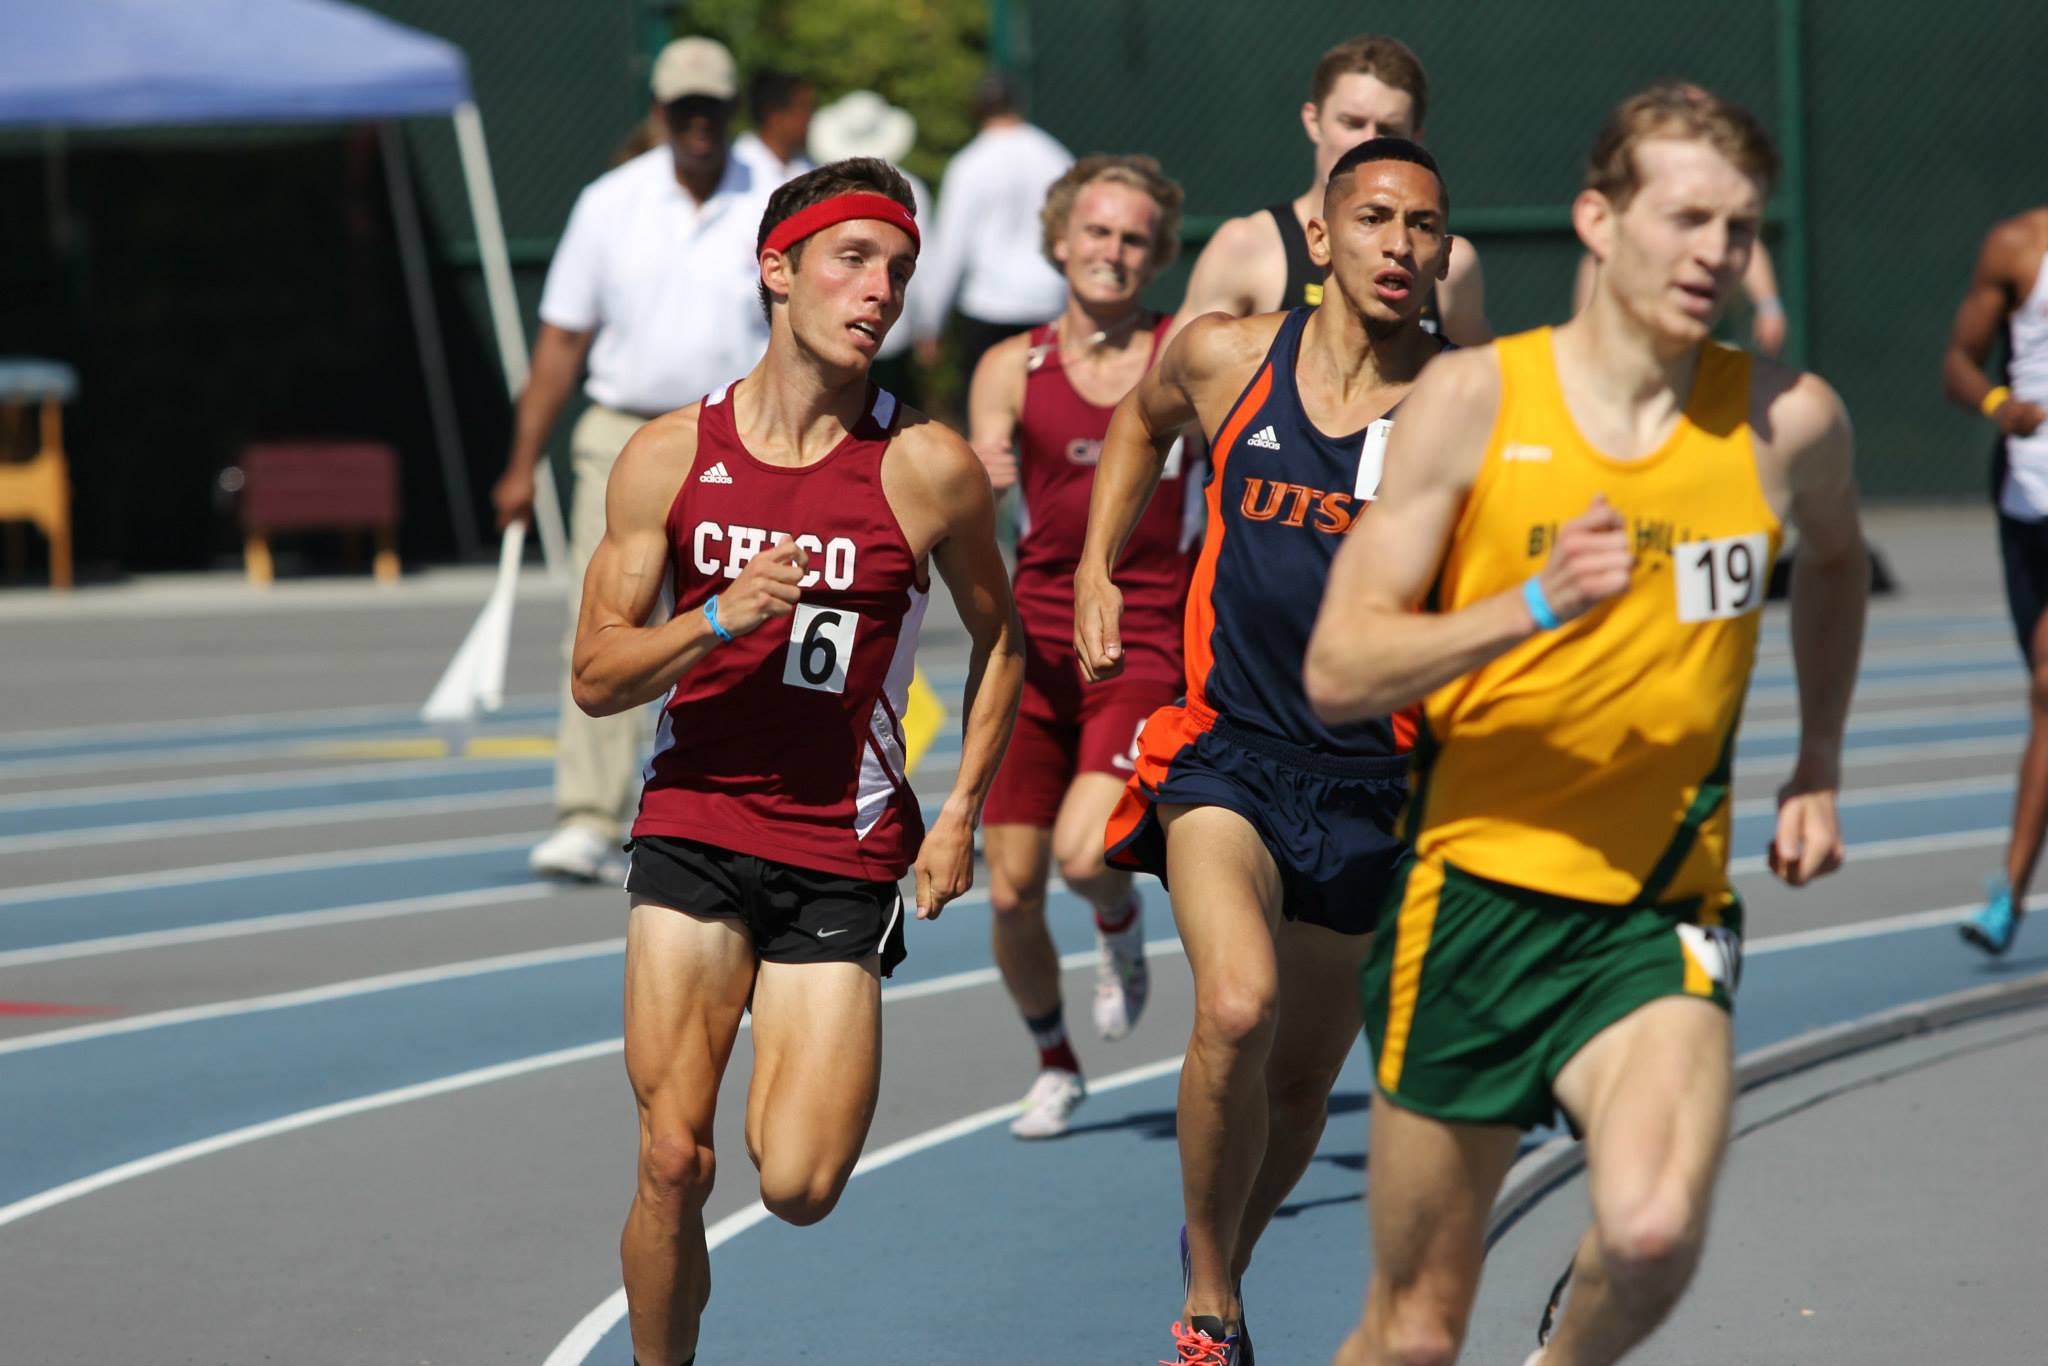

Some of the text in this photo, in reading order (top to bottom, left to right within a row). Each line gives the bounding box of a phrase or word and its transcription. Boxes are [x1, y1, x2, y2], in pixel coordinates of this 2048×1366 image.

[1247, 438, 1281, 450] adidas
[699, 475, 733, 485] adidas
[1241, 477, 1371, 534] UTS
[1694, 543, 1753, 612] 19
[799, 610, 842, 685] 6
